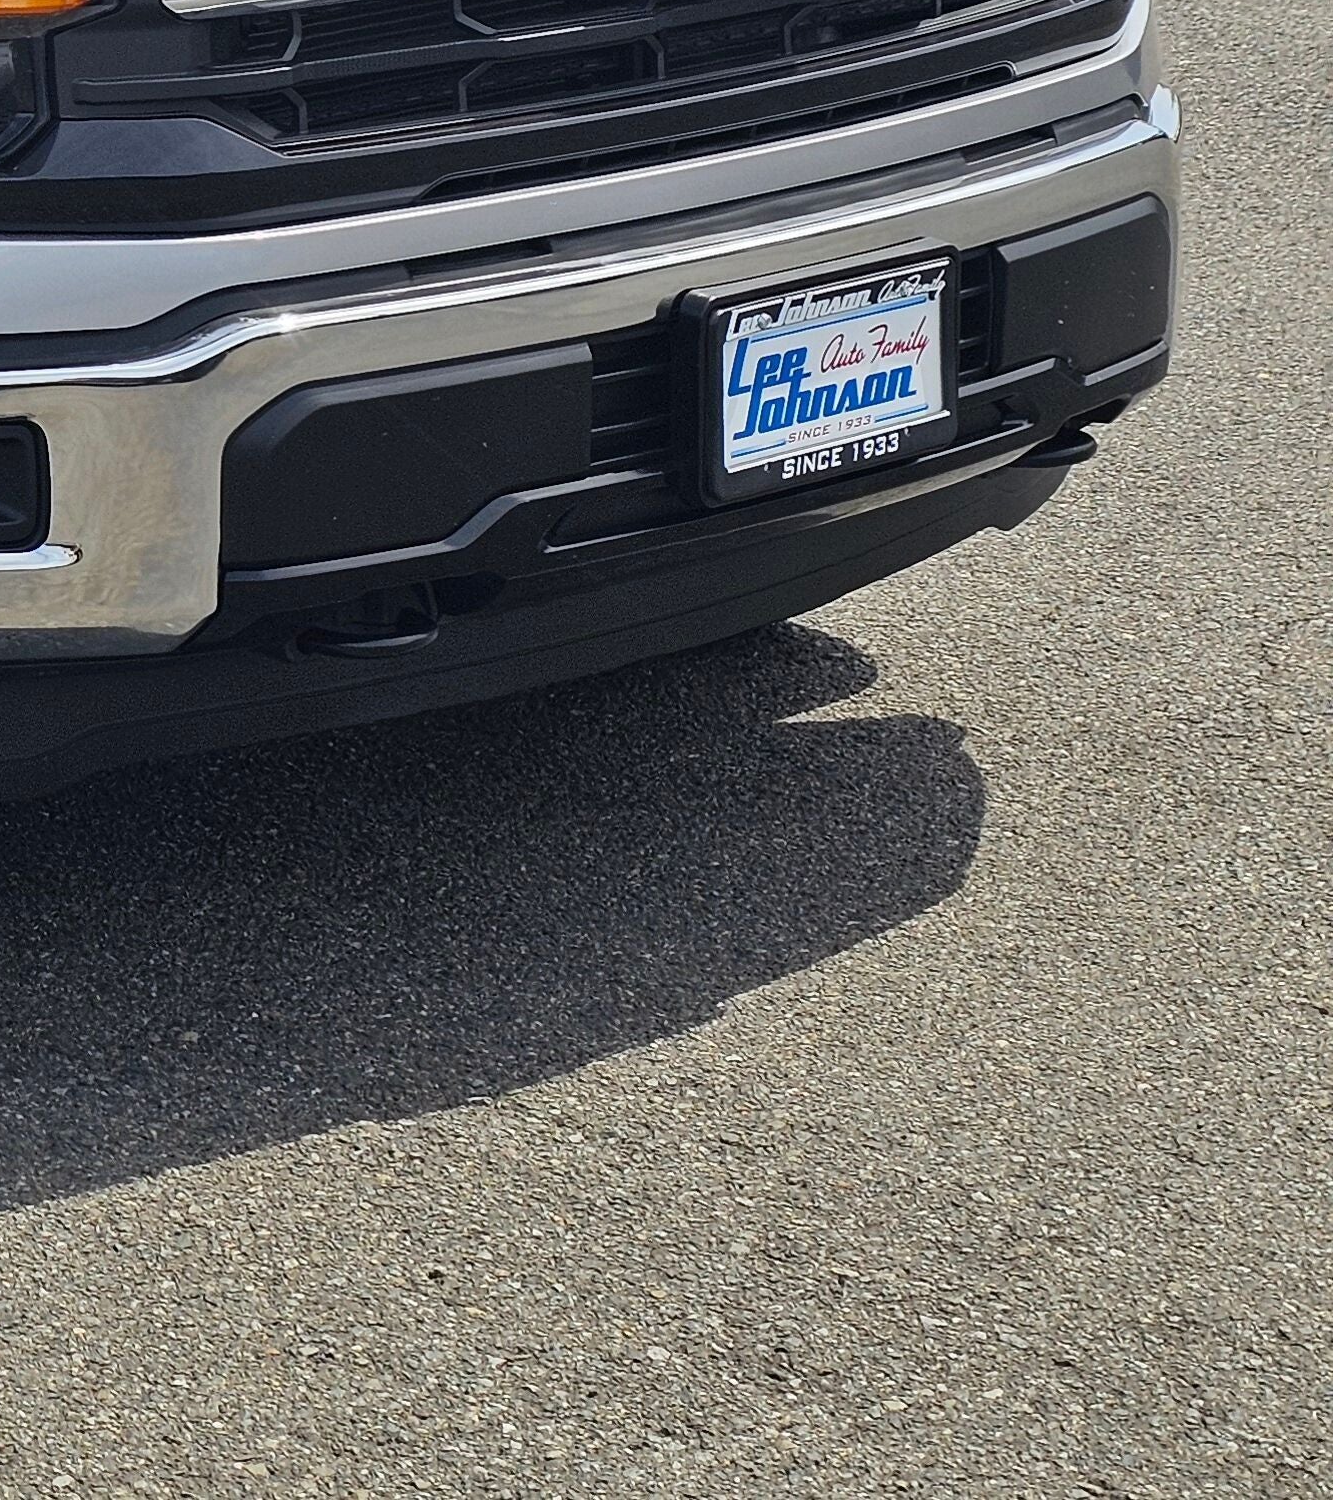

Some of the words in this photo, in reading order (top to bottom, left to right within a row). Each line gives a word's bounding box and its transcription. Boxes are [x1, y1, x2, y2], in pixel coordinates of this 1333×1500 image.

[772, 290, 873, 327] Johnson
[727, 337, 811, 397] Lee
[820, 333, 864, 374] Auto
[867, 315, 930, 364] Family
[733, 364, 918, 441] Johnson
[788, 423, 830, 444] SINCE
[837, 414, 872, 432] 1933
[781, 446, 844, 480] SINCE
[851, 431, 900, 463] 1933
